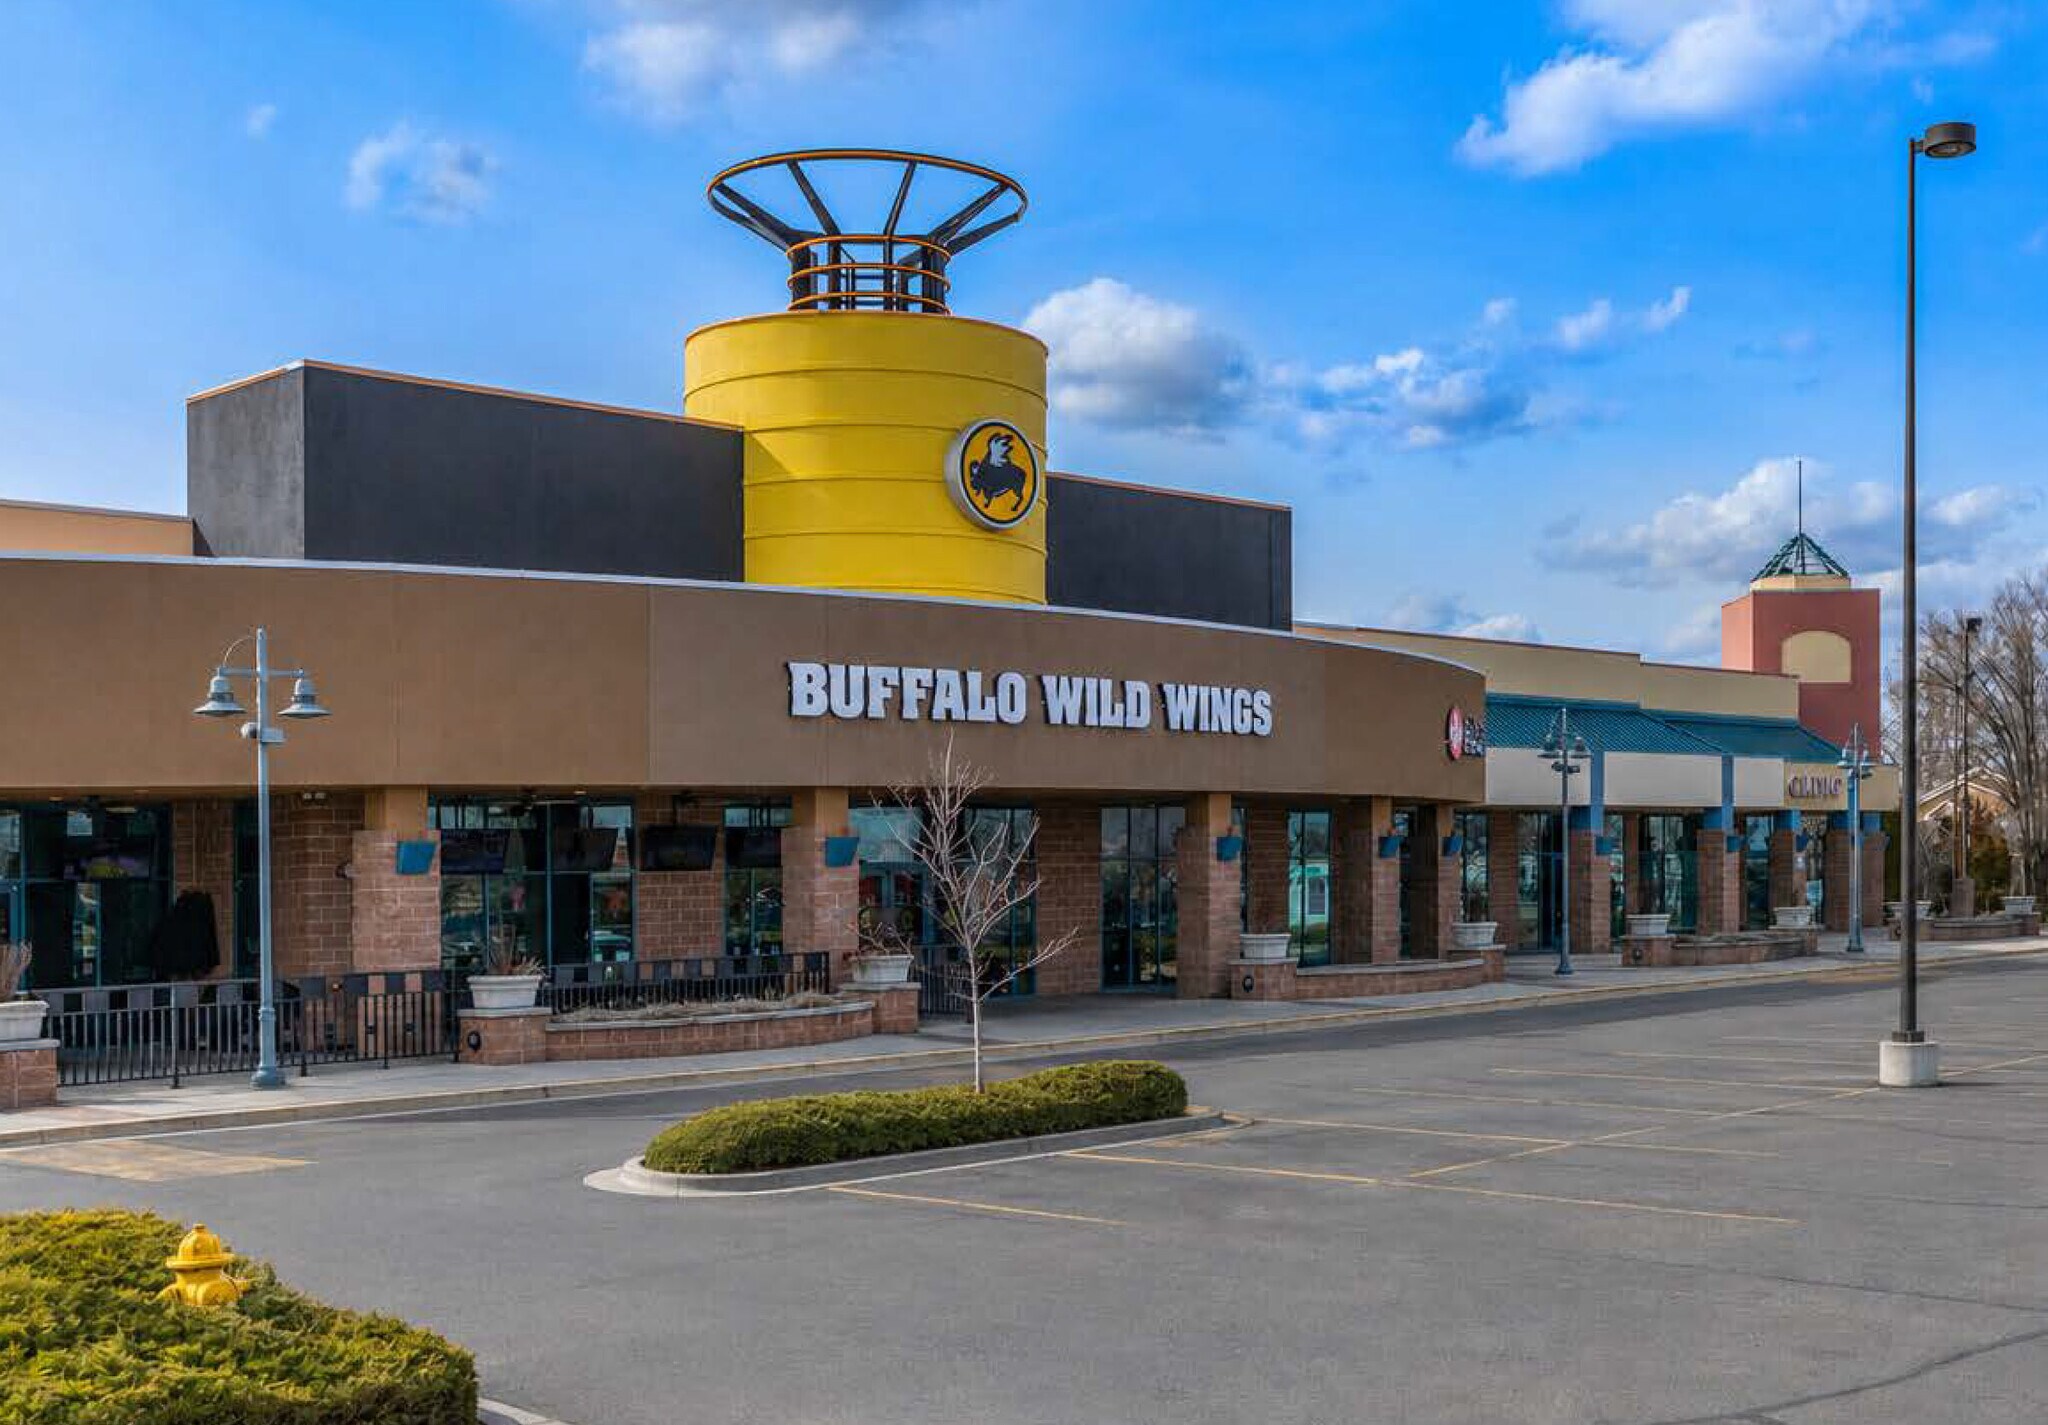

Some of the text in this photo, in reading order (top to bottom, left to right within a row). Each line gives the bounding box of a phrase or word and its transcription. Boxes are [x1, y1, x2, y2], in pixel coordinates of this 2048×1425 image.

[787, 661, 1272, 736] BUFFALO WILD WINGS
